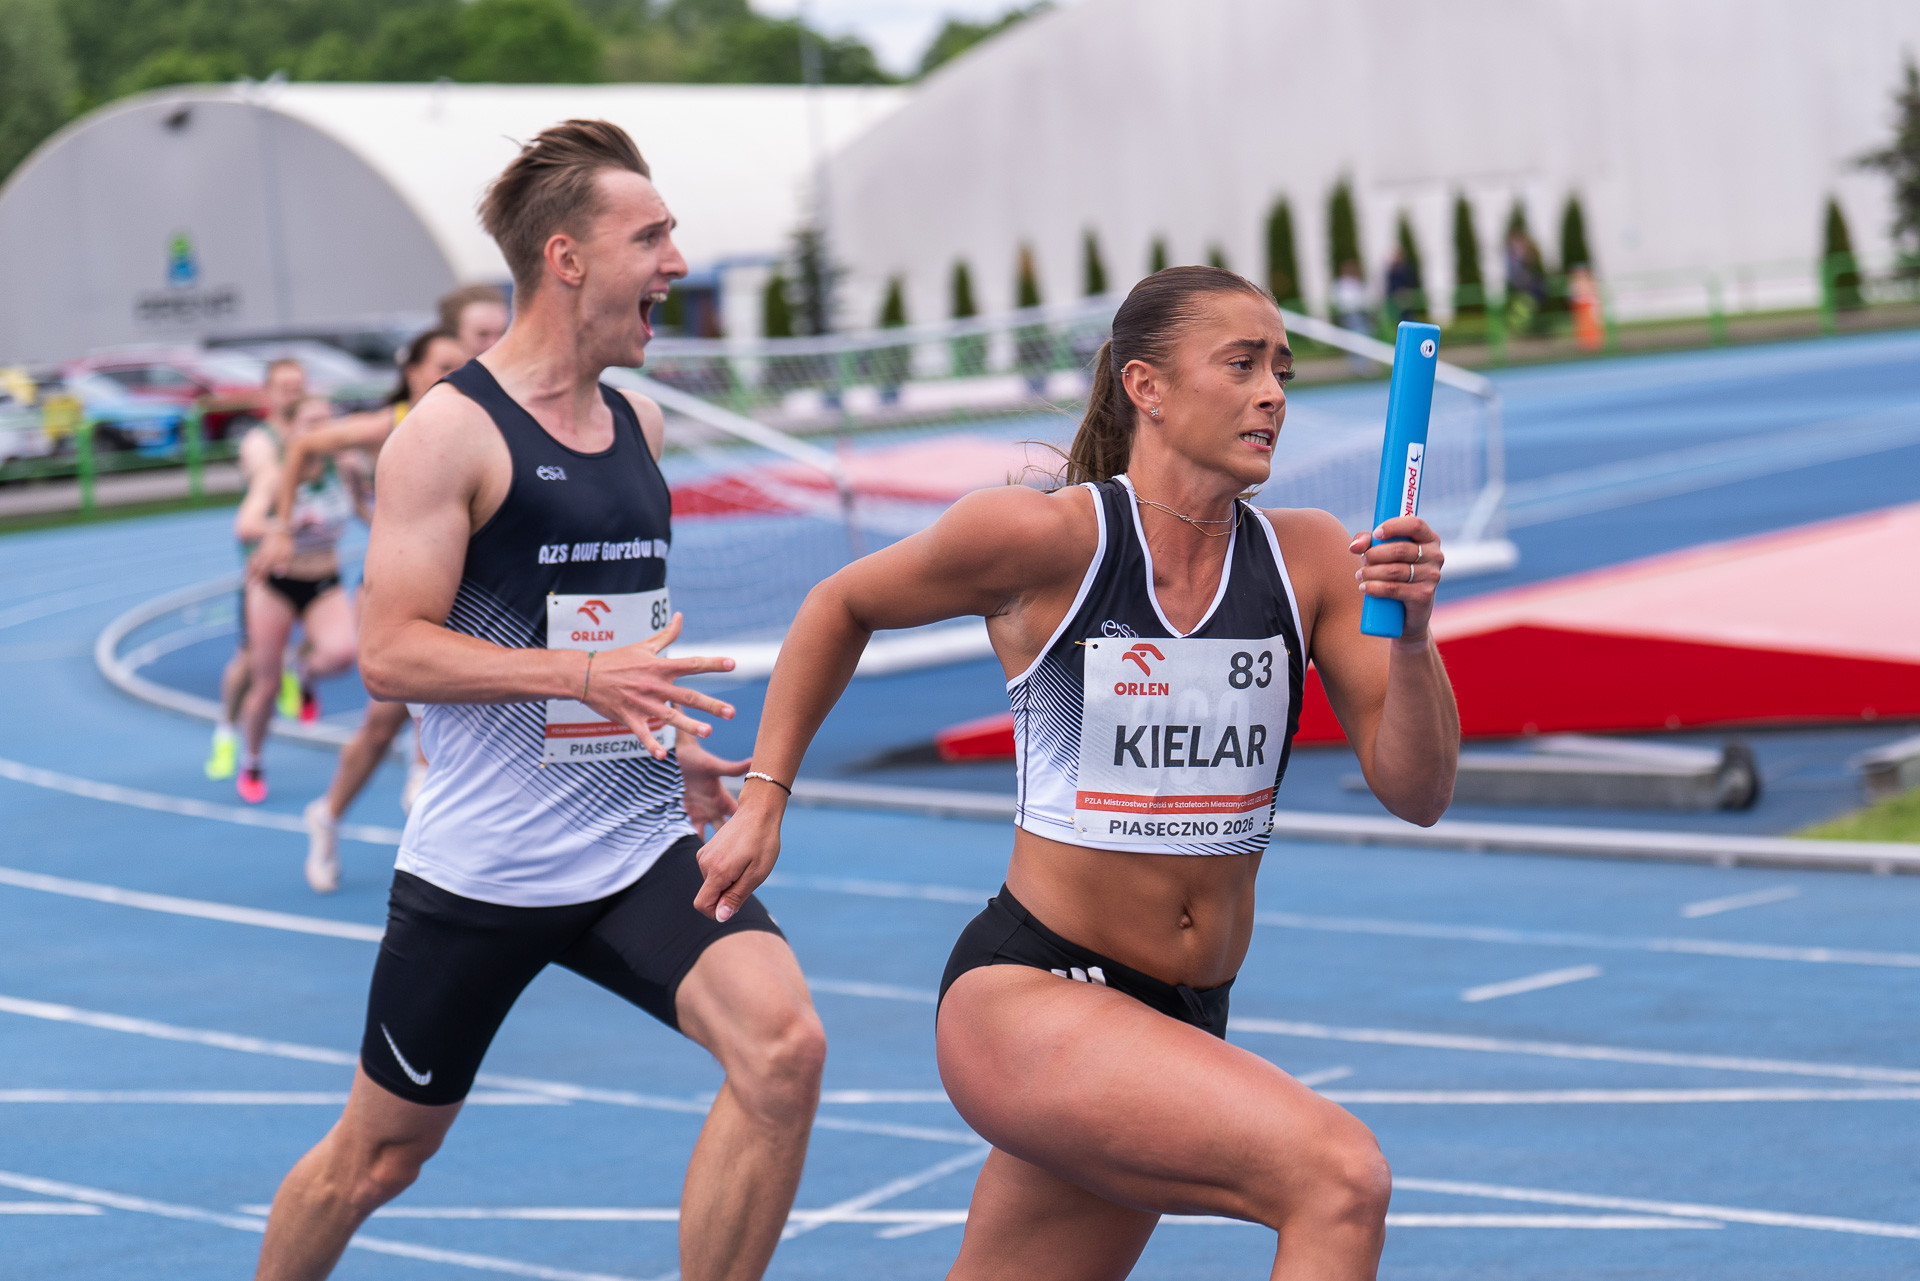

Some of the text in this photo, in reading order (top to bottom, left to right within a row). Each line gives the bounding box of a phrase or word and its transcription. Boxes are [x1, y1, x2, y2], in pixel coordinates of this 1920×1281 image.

[536, 465, 568, 481] esa
[1405, 466, 1417, 516] polanik
[538, 543, 569, 565] AZS
[571, 541, 601, 562] AWF
[601, 536, 652, 561] Gorzów
[651, 597, 667, 630] 85
[571, 630, 614, 642] ORLEN
[1228, 650, 1273, 689] 83
[1113, 682, 1169, 696] ORLEN
[1113, 724, 1267, 768] KIELAR
[1084, 797, 1102, 805] PZLA
[1103, 798, 1148, 808] Mistrzostwa
[1149, 801, 1167, 809] Polski
[1210, 801, 1247, 809] Mieszanych
[1109, 817, 1254, 836] PIASECZNO 2026
